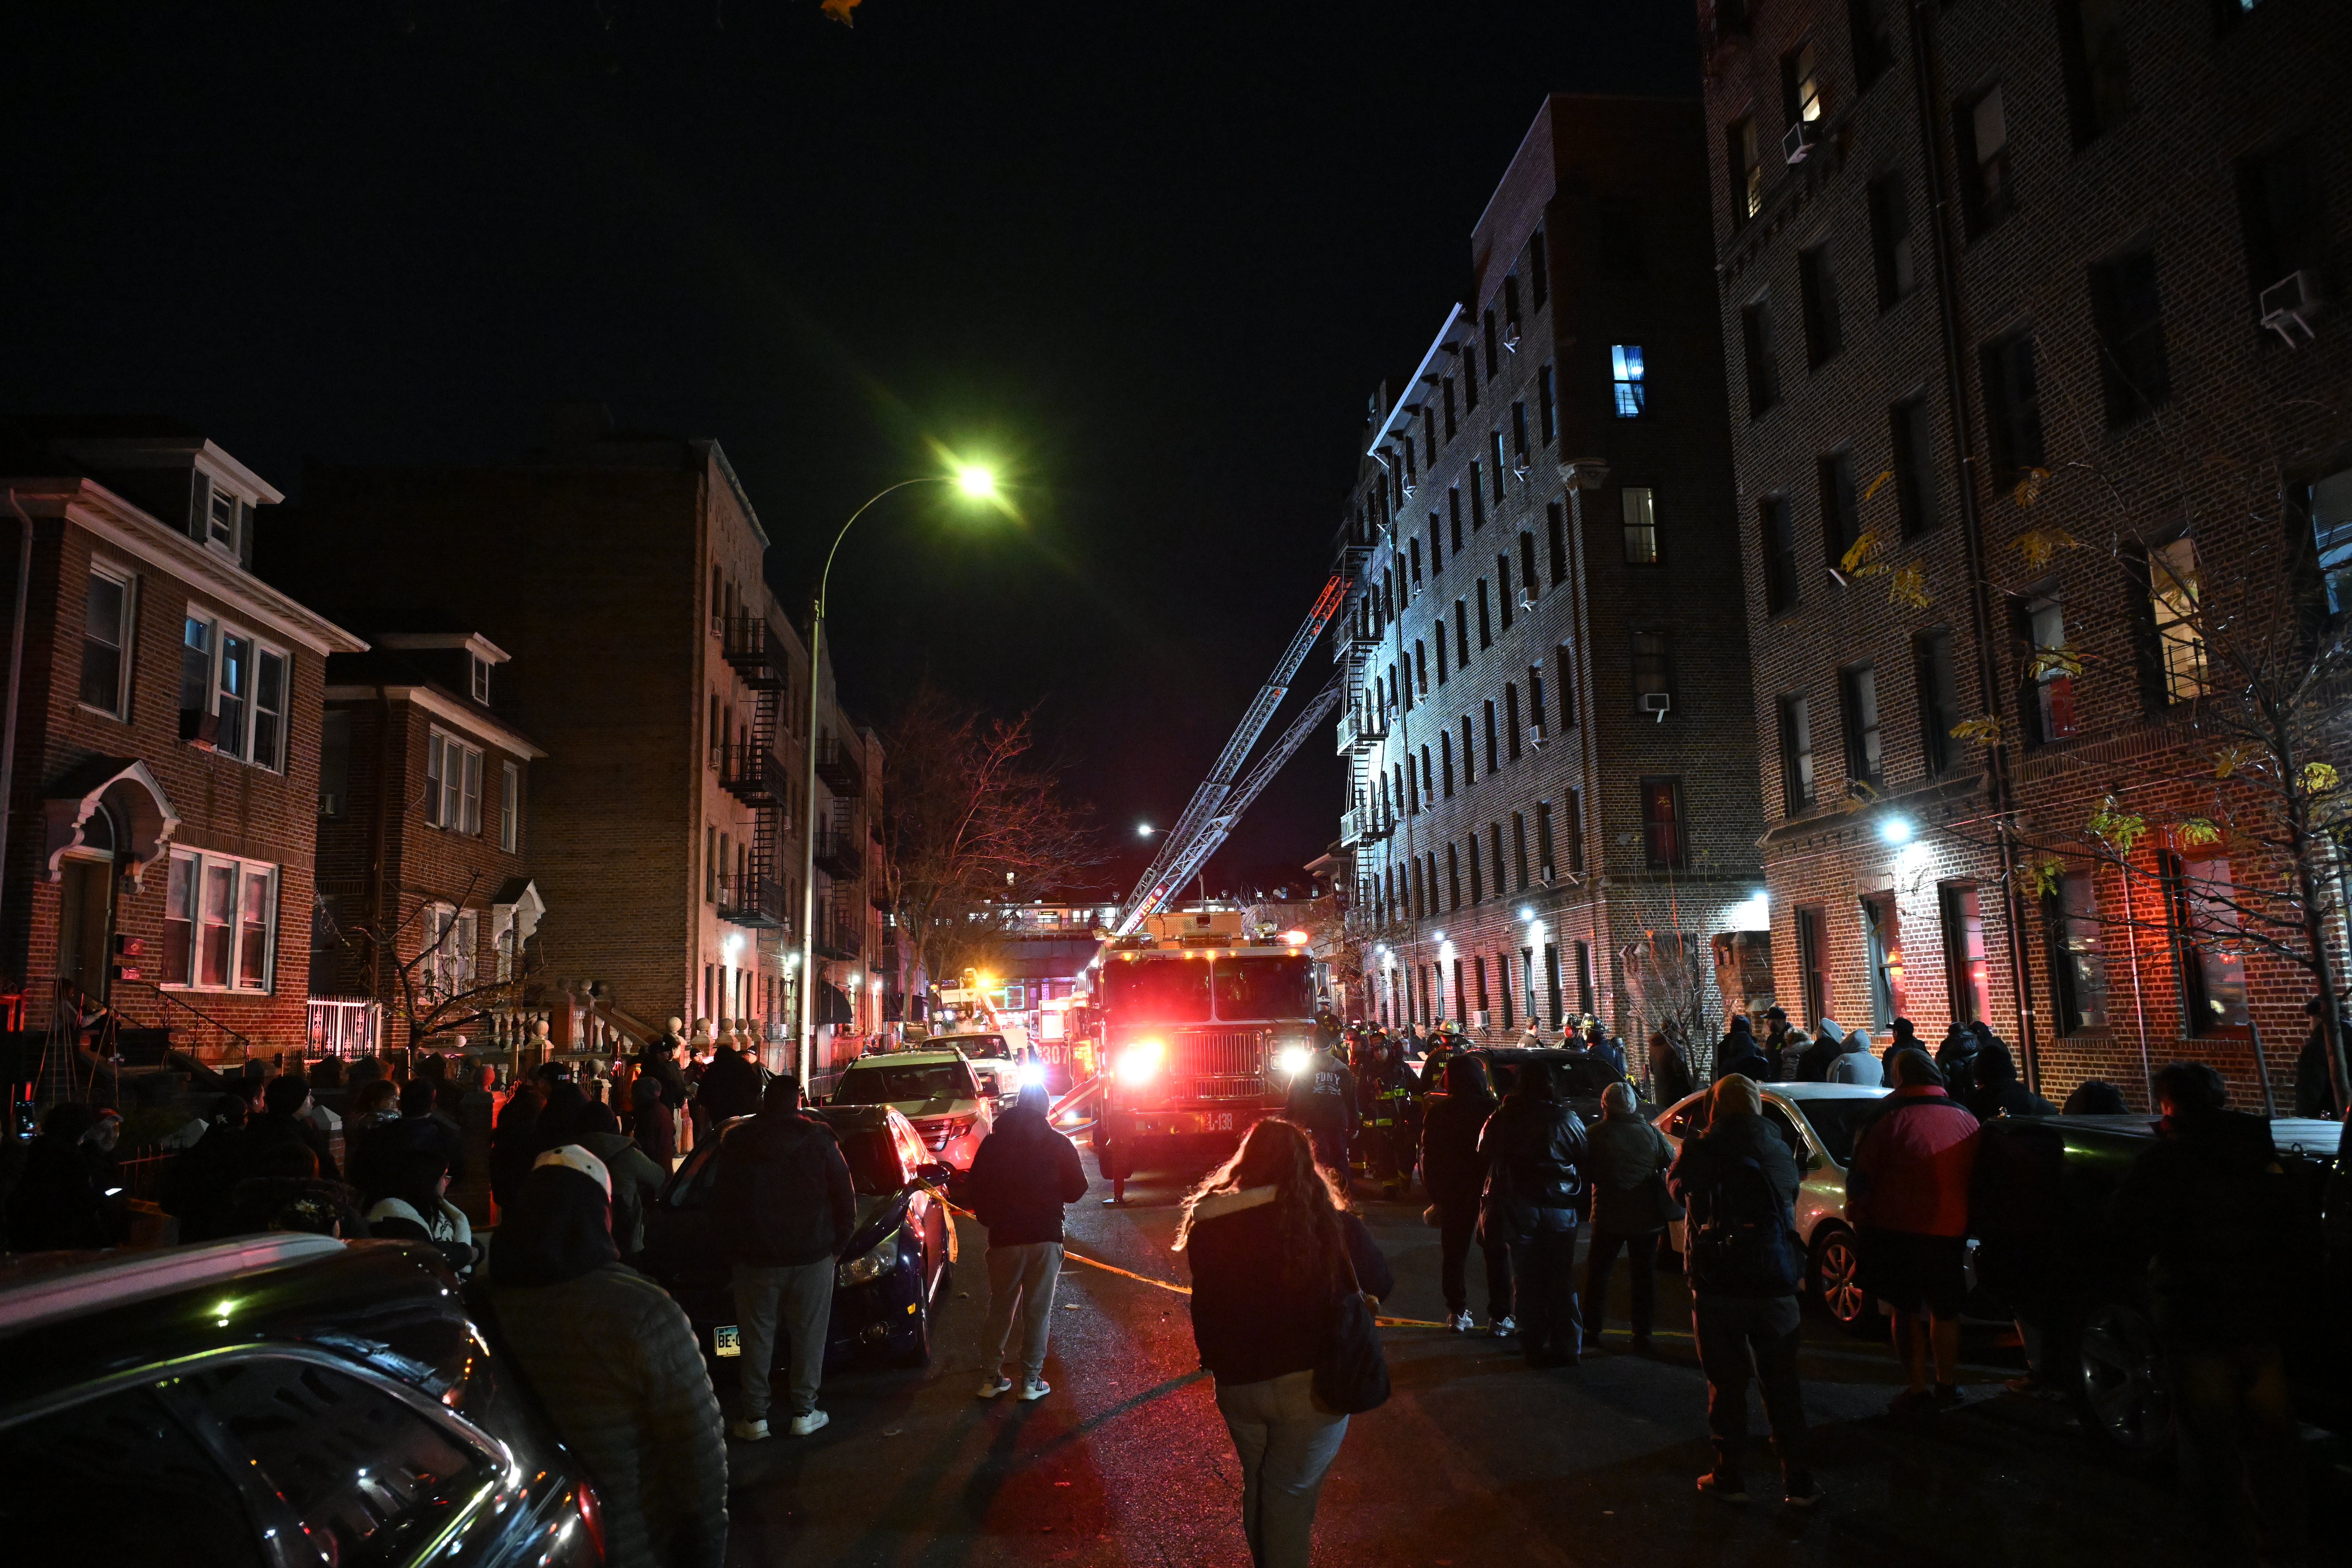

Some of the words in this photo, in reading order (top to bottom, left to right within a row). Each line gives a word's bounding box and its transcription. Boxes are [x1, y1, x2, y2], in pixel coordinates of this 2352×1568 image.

[1140, 895, 1157, 916] 154
[1315, 1072, 1340, 1086] FDNY
[1208, 1113, 1232, 1130] L-138
